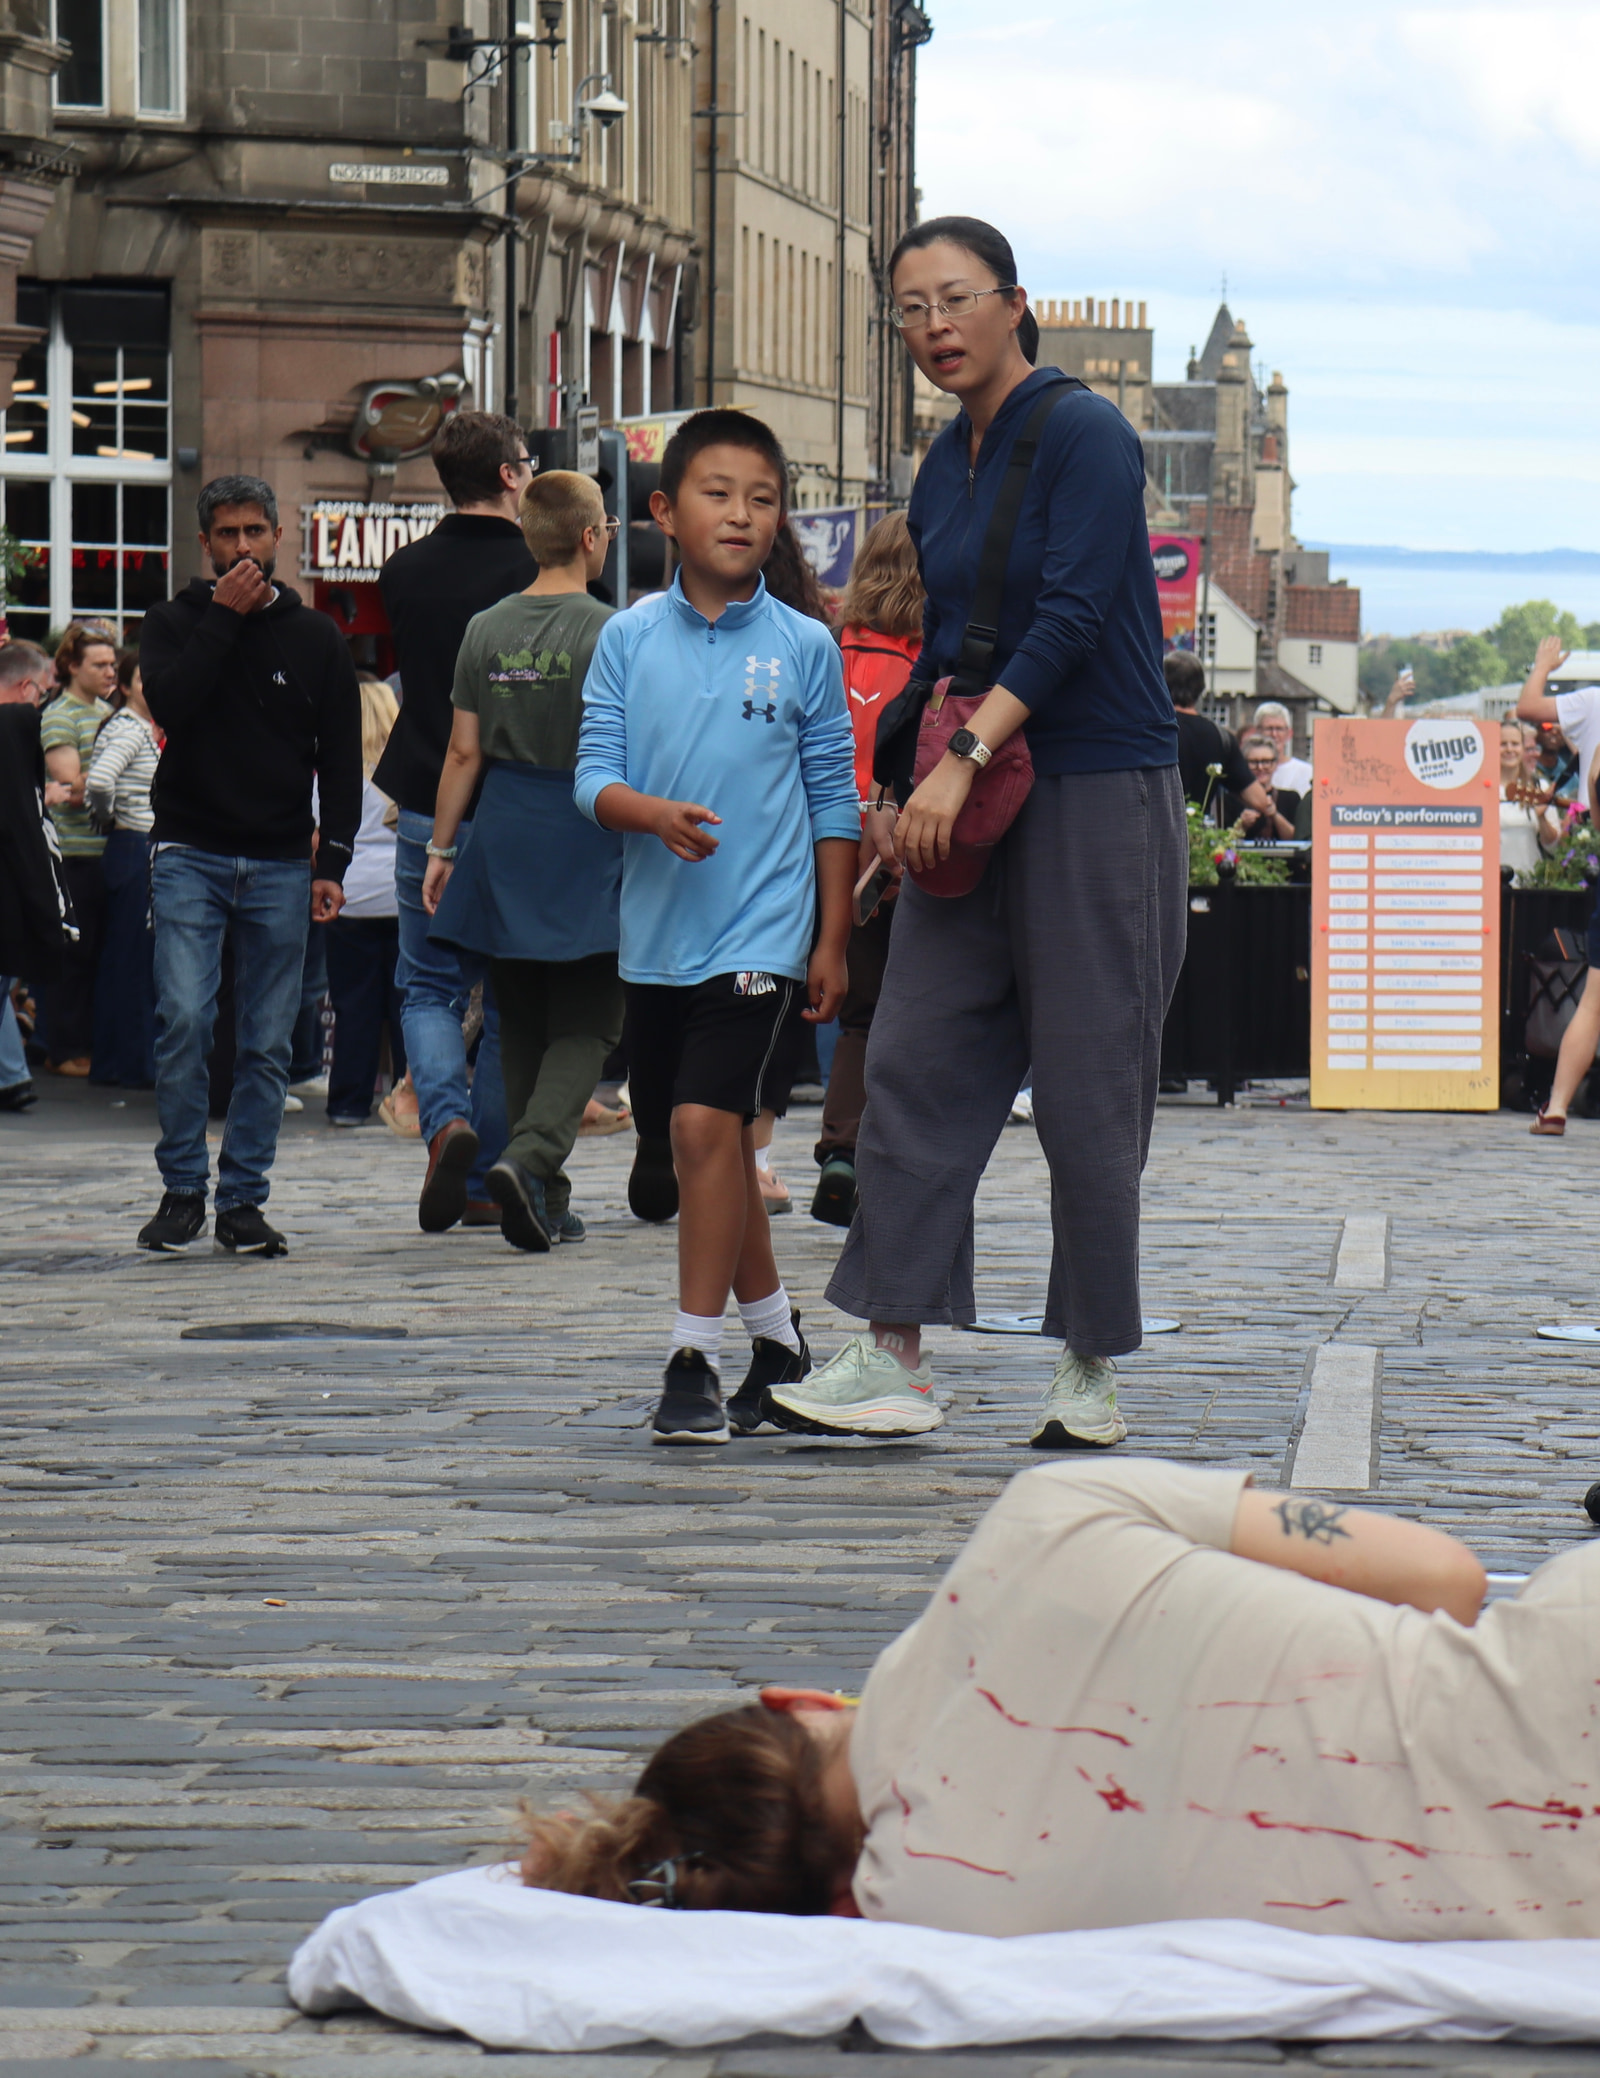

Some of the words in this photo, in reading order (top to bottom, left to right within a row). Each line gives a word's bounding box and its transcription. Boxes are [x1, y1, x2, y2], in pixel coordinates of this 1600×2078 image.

[334, 166, 384, 180] NORTH
[389, 167, 447, 182] BRIDGE
[318, 501, 365, 518] PROPER
[368, 502, 396, 519] FISH
[410, 503, 446, 521] CHIPS
[1411, 735, 1477, 764] fringe
[1419, 761, 1449, 773] street
[1420, 768, 1454, 780] events
[1335, 807, 1392, 825] Today's
[1395, 808, 1477, 825] performers
[747, 971, 777, 996] NBA
